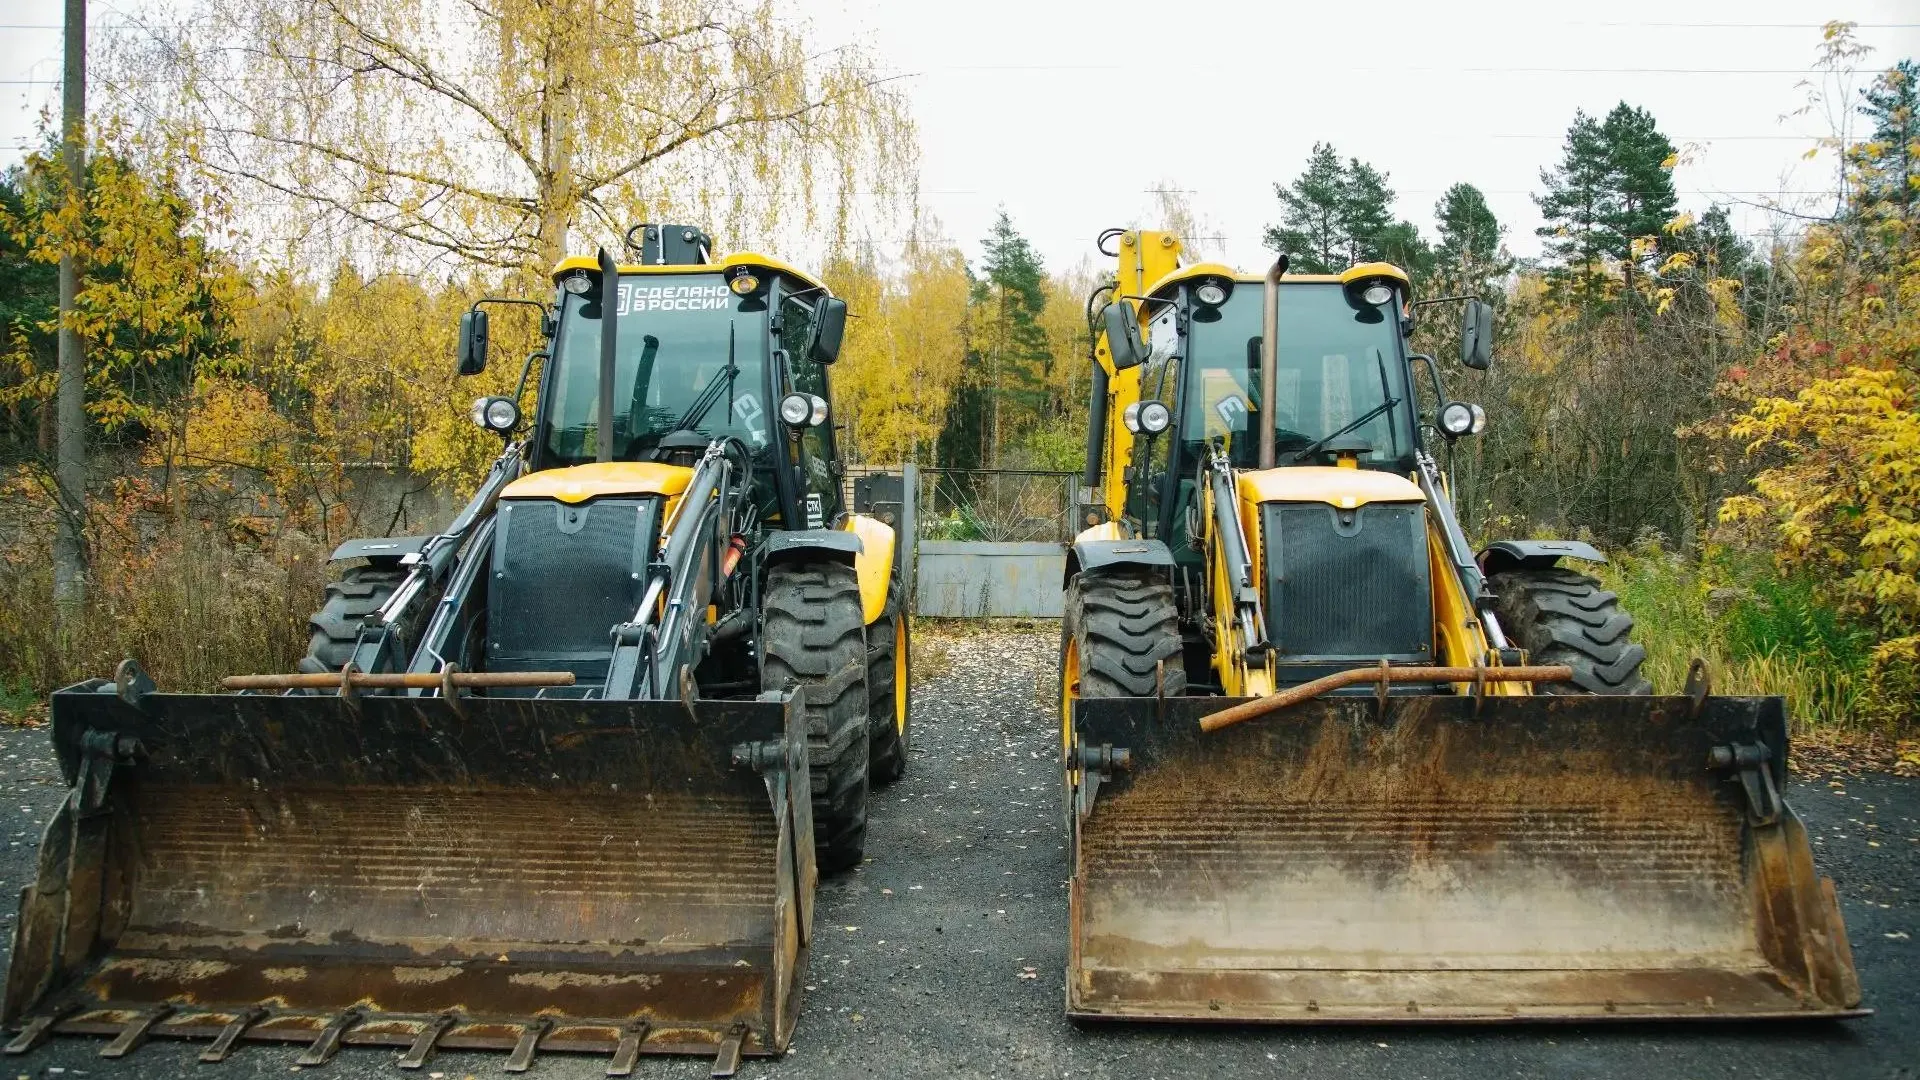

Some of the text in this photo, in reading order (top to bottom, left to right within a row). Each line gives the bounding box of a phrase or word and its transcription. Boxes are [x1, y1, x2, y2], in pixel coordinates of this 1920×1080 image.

[634, 286, 730, 299] СДЕЛАНО
[633, 298, 729, 311] В РОССИИ
